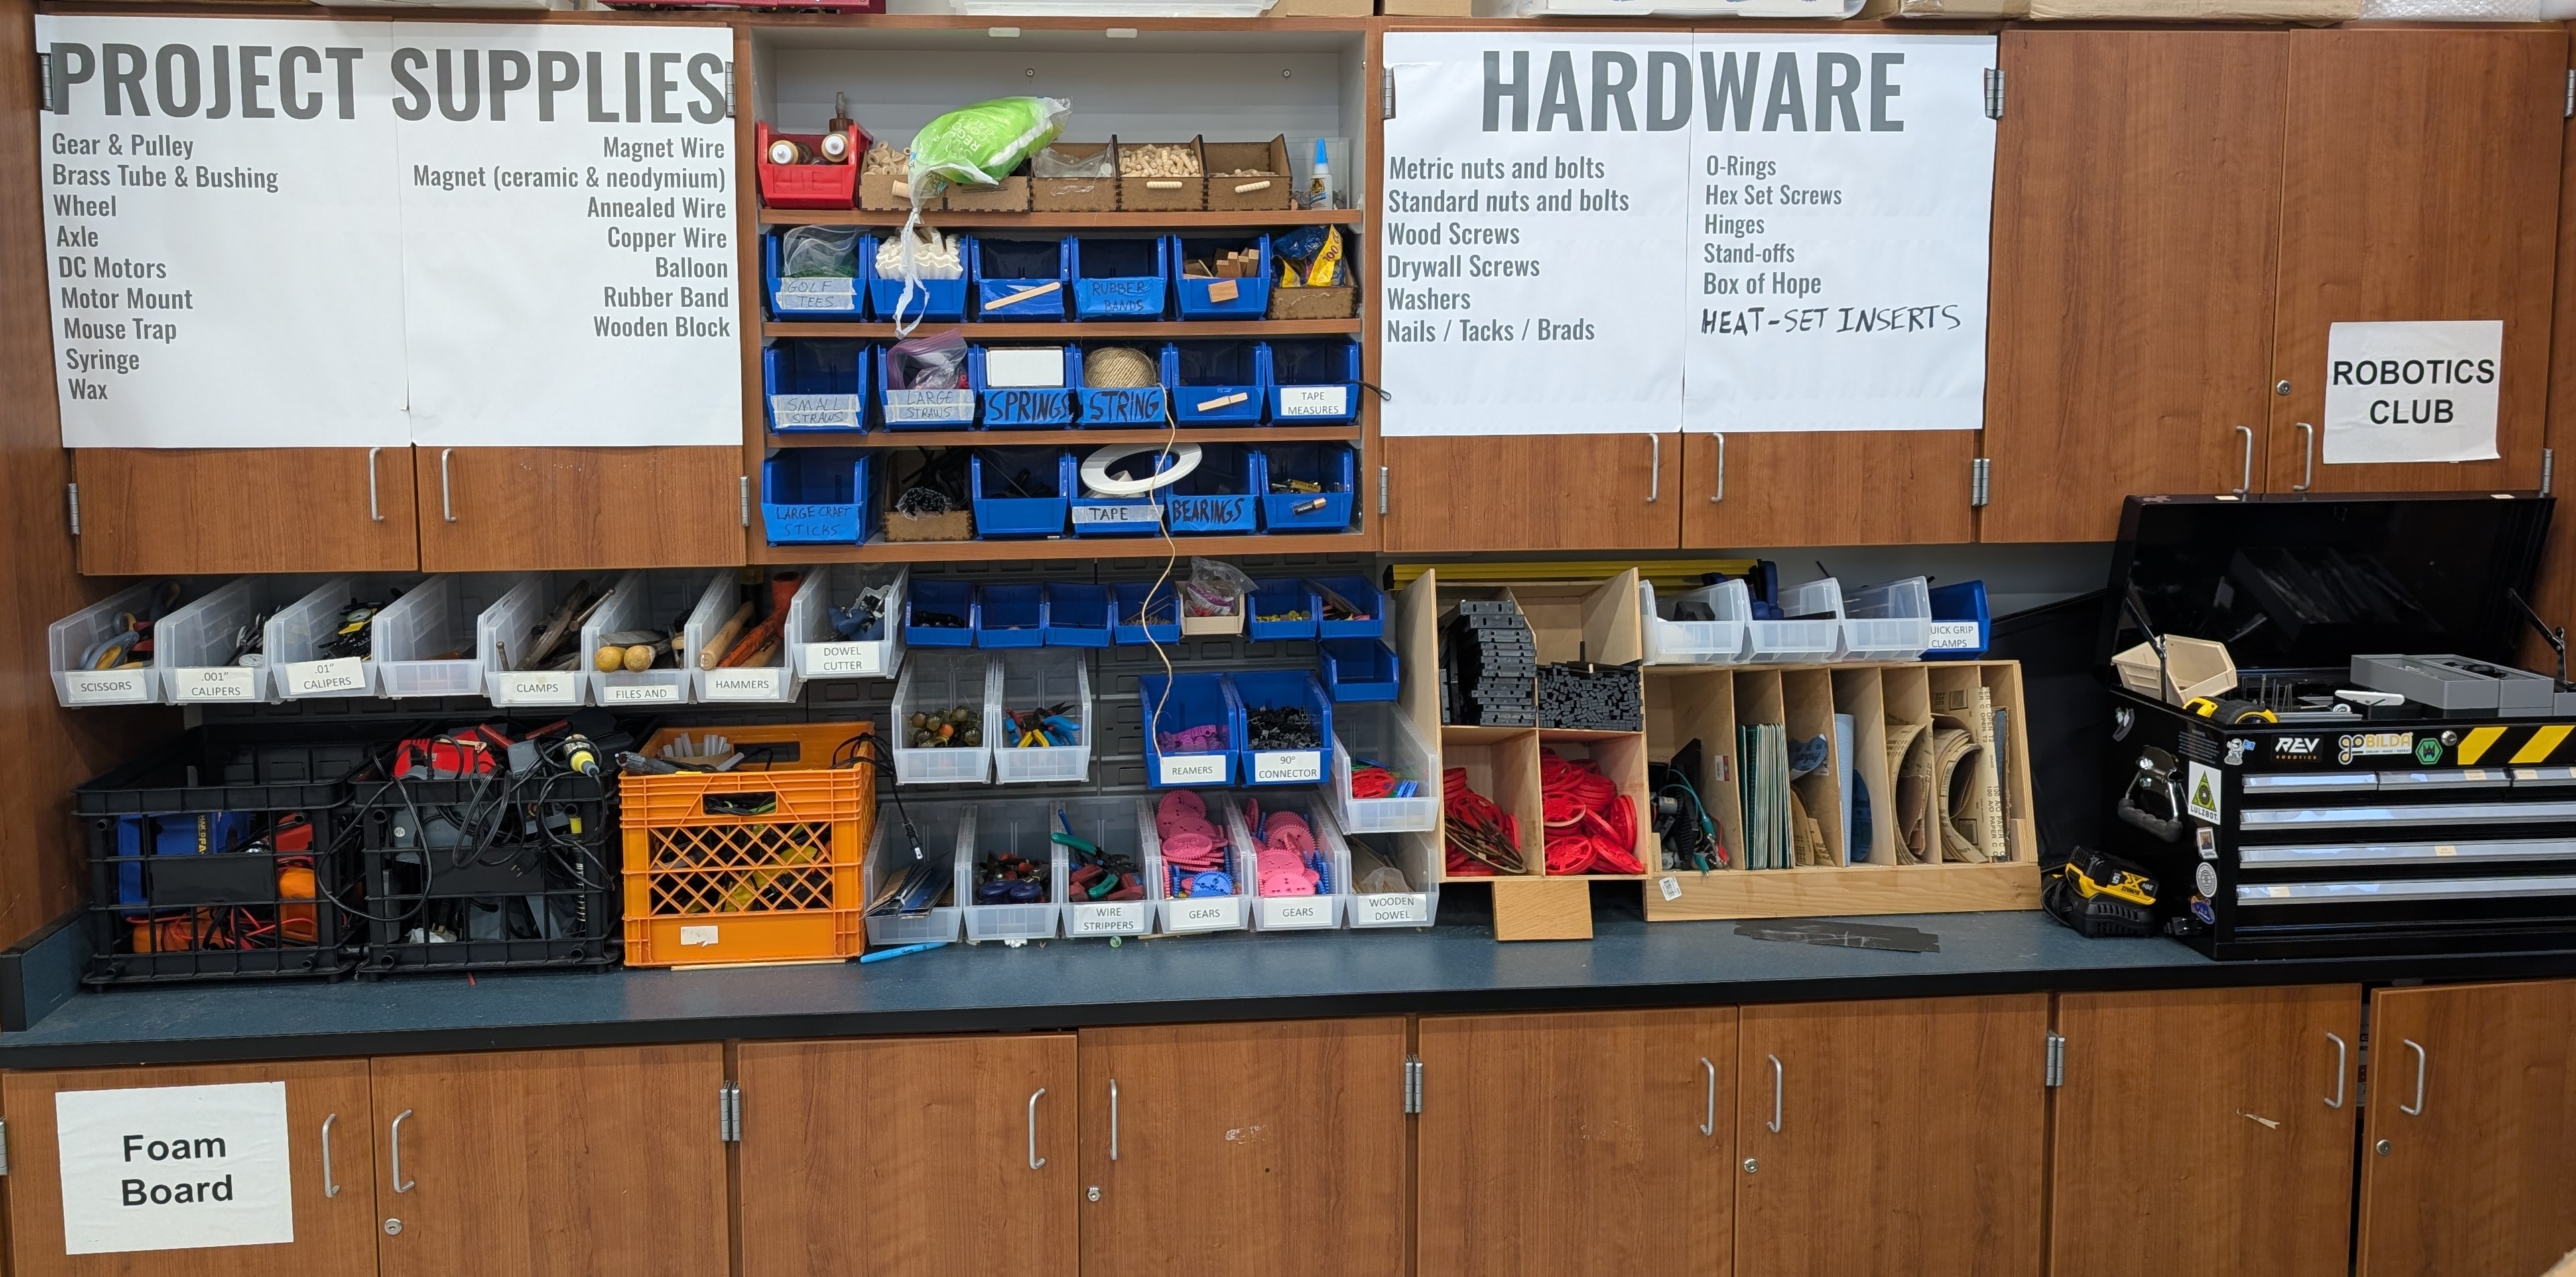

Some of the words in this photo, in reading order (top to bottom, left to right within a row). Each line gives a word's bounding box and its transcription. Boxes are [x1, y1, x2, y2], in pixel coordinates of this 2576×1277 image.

[50, 42, 363, 120] PROJECT
[391, 48, 726, 124] SUPPLIES
[1482, 50, 1905, 132] HARDWARE
[53, 133, 100, 155] Gear
[109, 134, 123, 155] &
[131, 135, 193, 160] Pulley
[604, 137, 673, 162] Magnet
[681, 137, 724, 158] Wire
[1390, 157, 1453, 180] Metric
[1462, 158, 1504, 179] nuts
[1512, 156, 1547, 179] and
[1555, 156, 1604, 179] bolts
[1707, 155, 1776, 180] O-Rings
[53, 163, 110, 186] Brass
[117, 165, 166, 186] Tube
[175, 165, 188, 187] &
[196, 166, 278, 193] Bushing
[414, 165, 486, 191] Magnet
[495, 165, 578, 191] (ceramic
[586, 167, 598, 187] &
[607, 167, 724, 192] neodymium)
[53, 194, 116, 216] Wheel
[1389, 190, 1478, 212] Standard
[1486, 191, 1529, 212] nuts
[1537, 189, 1571, 212] and
[1580, 189, 1628, 211] bolts
[1706, 185, 1738, 204] Hex
[1744, 185, 1773, 205] Set
[1780, 185, 1842, 204] Screws
[588, 197, 674, 218] Annealed
[682, 197, 726, 218] Wire
[57, 226, 98, 247] Axle
[1388, 222, 1440, 245] Wood
[1450, 222, 1519, 245] Screws
[1705, 214, 1764, 239] Hinges
[608, 226, 676, 252] Copper
[684, 227, 726, 248] Wire
[1323, 245, 1339, 261] 100
[1704, 243, 1795, 263] Stand-offs
[59, 257, 86, 277] DC
[94, 257, 166, 278] Motors
[656, 257, 727, 277] Balloon
[1388, 255, 1461, 281] Drywall
[1470, 255, 1539, 277] Screws
[788, 281, 832, 293] GOLF
[1092, 281, 1144, 295] RUBBER
[1704, 273, 1739, 294] Box
[1746, 273, 1765, 294] of
[1773, 272, 1821, 298] Hope
[62, 287, 119, 308] Motor
[127, 287, 193, 309] Mount
[604, 287, 673, 307] Rubber
[681, 287, 728, 308] Band
[797, 296, 834, 307] TEES
[1104, 299, 1144, 312] BANDS
[1388, 287, 1470, 310] Washers
[594, 316, 667, 336] Wooden
[676, 316, 730, 337] Block
[1388, 320, 1435, 342] Nails
[1443, 320, 1452, 342] /
[1460, 319, 1514, 341] Tacks
[1522, 319, 1530, 340] /
[1539, 318, 1594, 340] Brads
[1701, 308, 1829, 336] HEAT-SET
[1836, 305, 1960, 332] INSERTS
[64, 318, 125, 339] Mouse
[132, 318, 176, 344] Trap
[66, 348, 139, 374] Syringe
[2333, 359, 2494, 385] ROBOTICS
[68, 379, 108, 399] Wax
[907, 391, 953, 404] LARGE
[1302, 392, 1325, 401] TAPE
[788, 397, 840, 411] SMALL
[906, 407, 951, 418] STRAWS
[988, 391, 1070, 422] SPRINGS
[1090, 391, 1159, 421] STRING
[1288, 405, 1338, 415] MEASURES
[2370, 399, 2453, 424] CLUB
[793, 412, 844, 423] STRAWS
[777, 507, 815, 519] LARGE
[818, 507, 852, 517] CRAFT
[1089, 508, 1129, 521] TAPE
[1172, 497, 1242, 524] BEARINGS
[785, 524, 838, 536] STICKS
[1930, 626, 1951, 635] UICK
[824, 647, 862, 656] DOWEL
[824, 661, 862, 670] CUTTER
[80, 681, 131, 692] SCISSORS
[192, 686, 241, 696] CALIPERS
[304, 677, 352, 689] CALIPERS
[517, 683, 559, 693] CLAMPS
[716, 679, 769, 689] HAMMERS
[617, 689, 641, 699] FILES
[645, 688, 667, 698] AND
[2275, 738, 2320, 752] REV
[1172, 766, 1213, 775] REAMERS
[1259, 768, 1317, 778] CONNECTOR
[2191, 805, 2217, 820] LULZBOT
[1369, 897, 1414, 906] WOODEN
[1096, 908, 1121, 917] WIRE
[1189, 909, 1220, 918] GEARS
[1283, 908, 1313, 917] GEARS
[1375, 910, 1410, 920] DOWEL
[1084, 921, 1134, 931] STRIPPERS
[123, 1135, 226, 1162] Foam
[122, 1174, 233, 1206] Board
